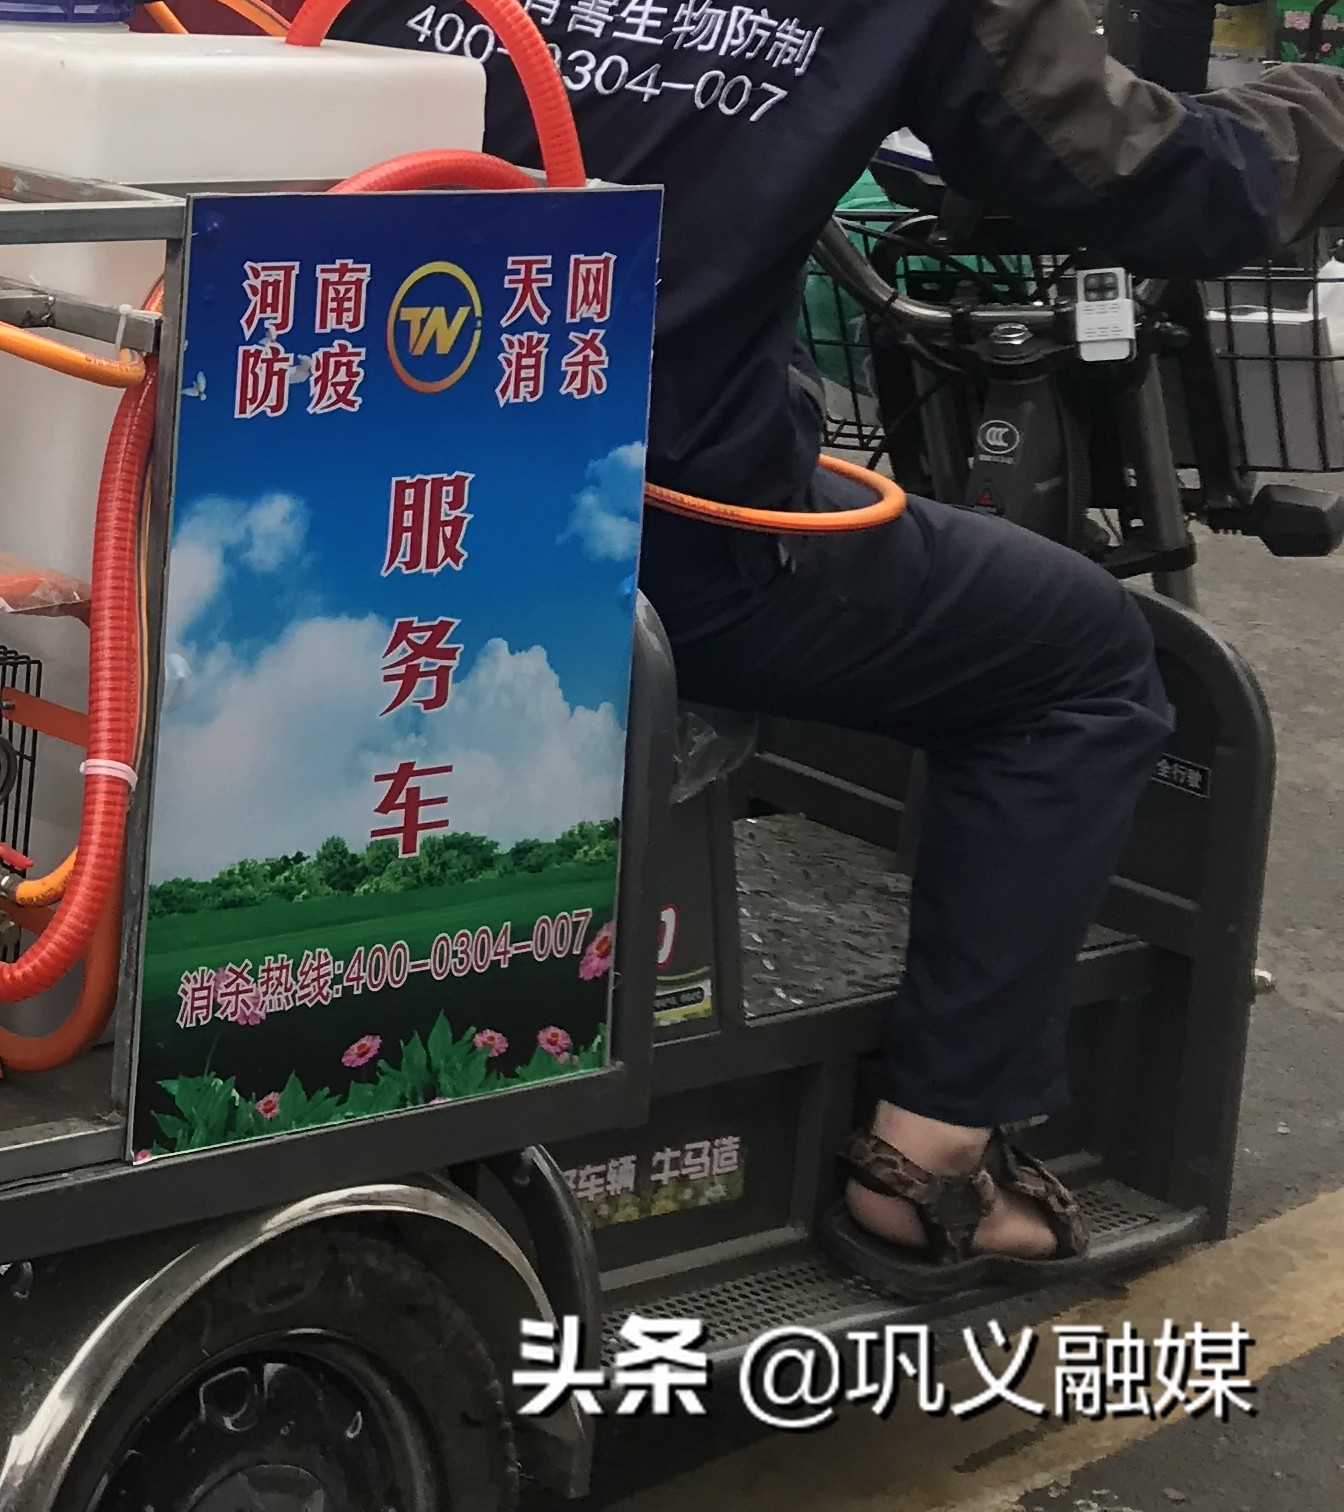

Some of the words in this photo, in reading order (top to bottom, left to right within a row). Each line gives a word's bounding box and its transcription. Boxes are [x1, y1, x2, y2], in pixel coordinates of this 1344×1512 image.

[240, 258, 372, 340] 河南
[499, 251, 617, 328] 天网
[233, 340, 367, 419] 防疫
[495, 328, 609, 408] 消杀
[369, 470, 475, 858] 服务车
